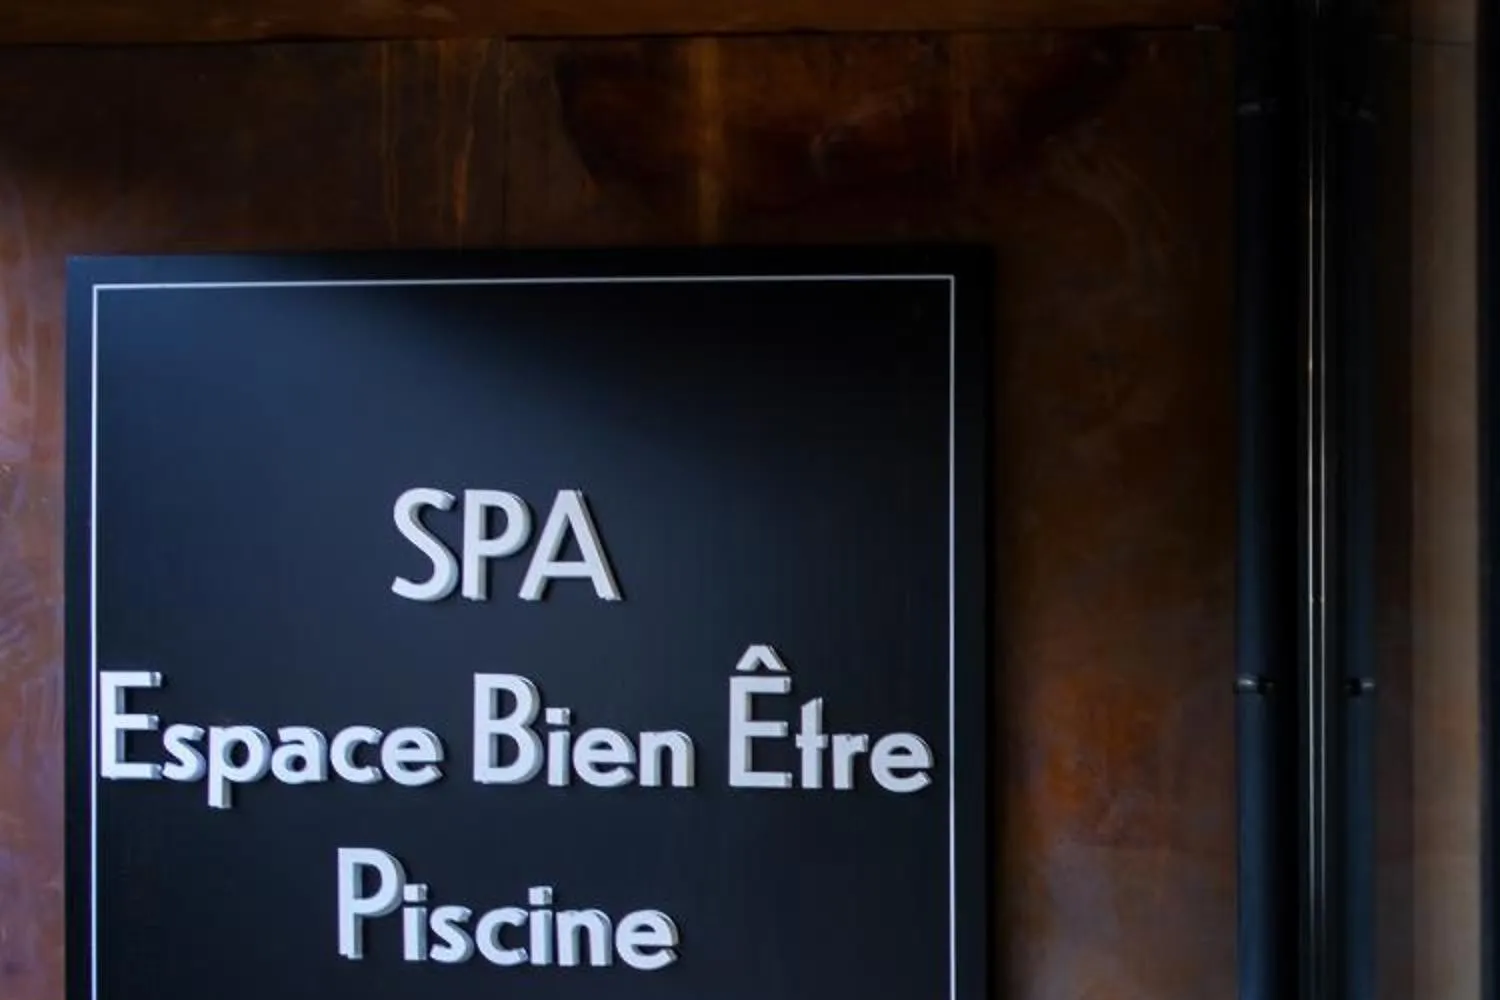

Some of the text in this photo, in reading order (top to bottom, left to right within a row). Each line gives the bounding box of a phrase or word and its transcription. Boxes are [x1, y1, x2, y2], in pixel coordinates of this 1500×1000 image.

[390, 486, 622, 602] SPA
[99, 644, 933, 809] Espace Bien Être
[336, 846, 679, 970] Piscine
